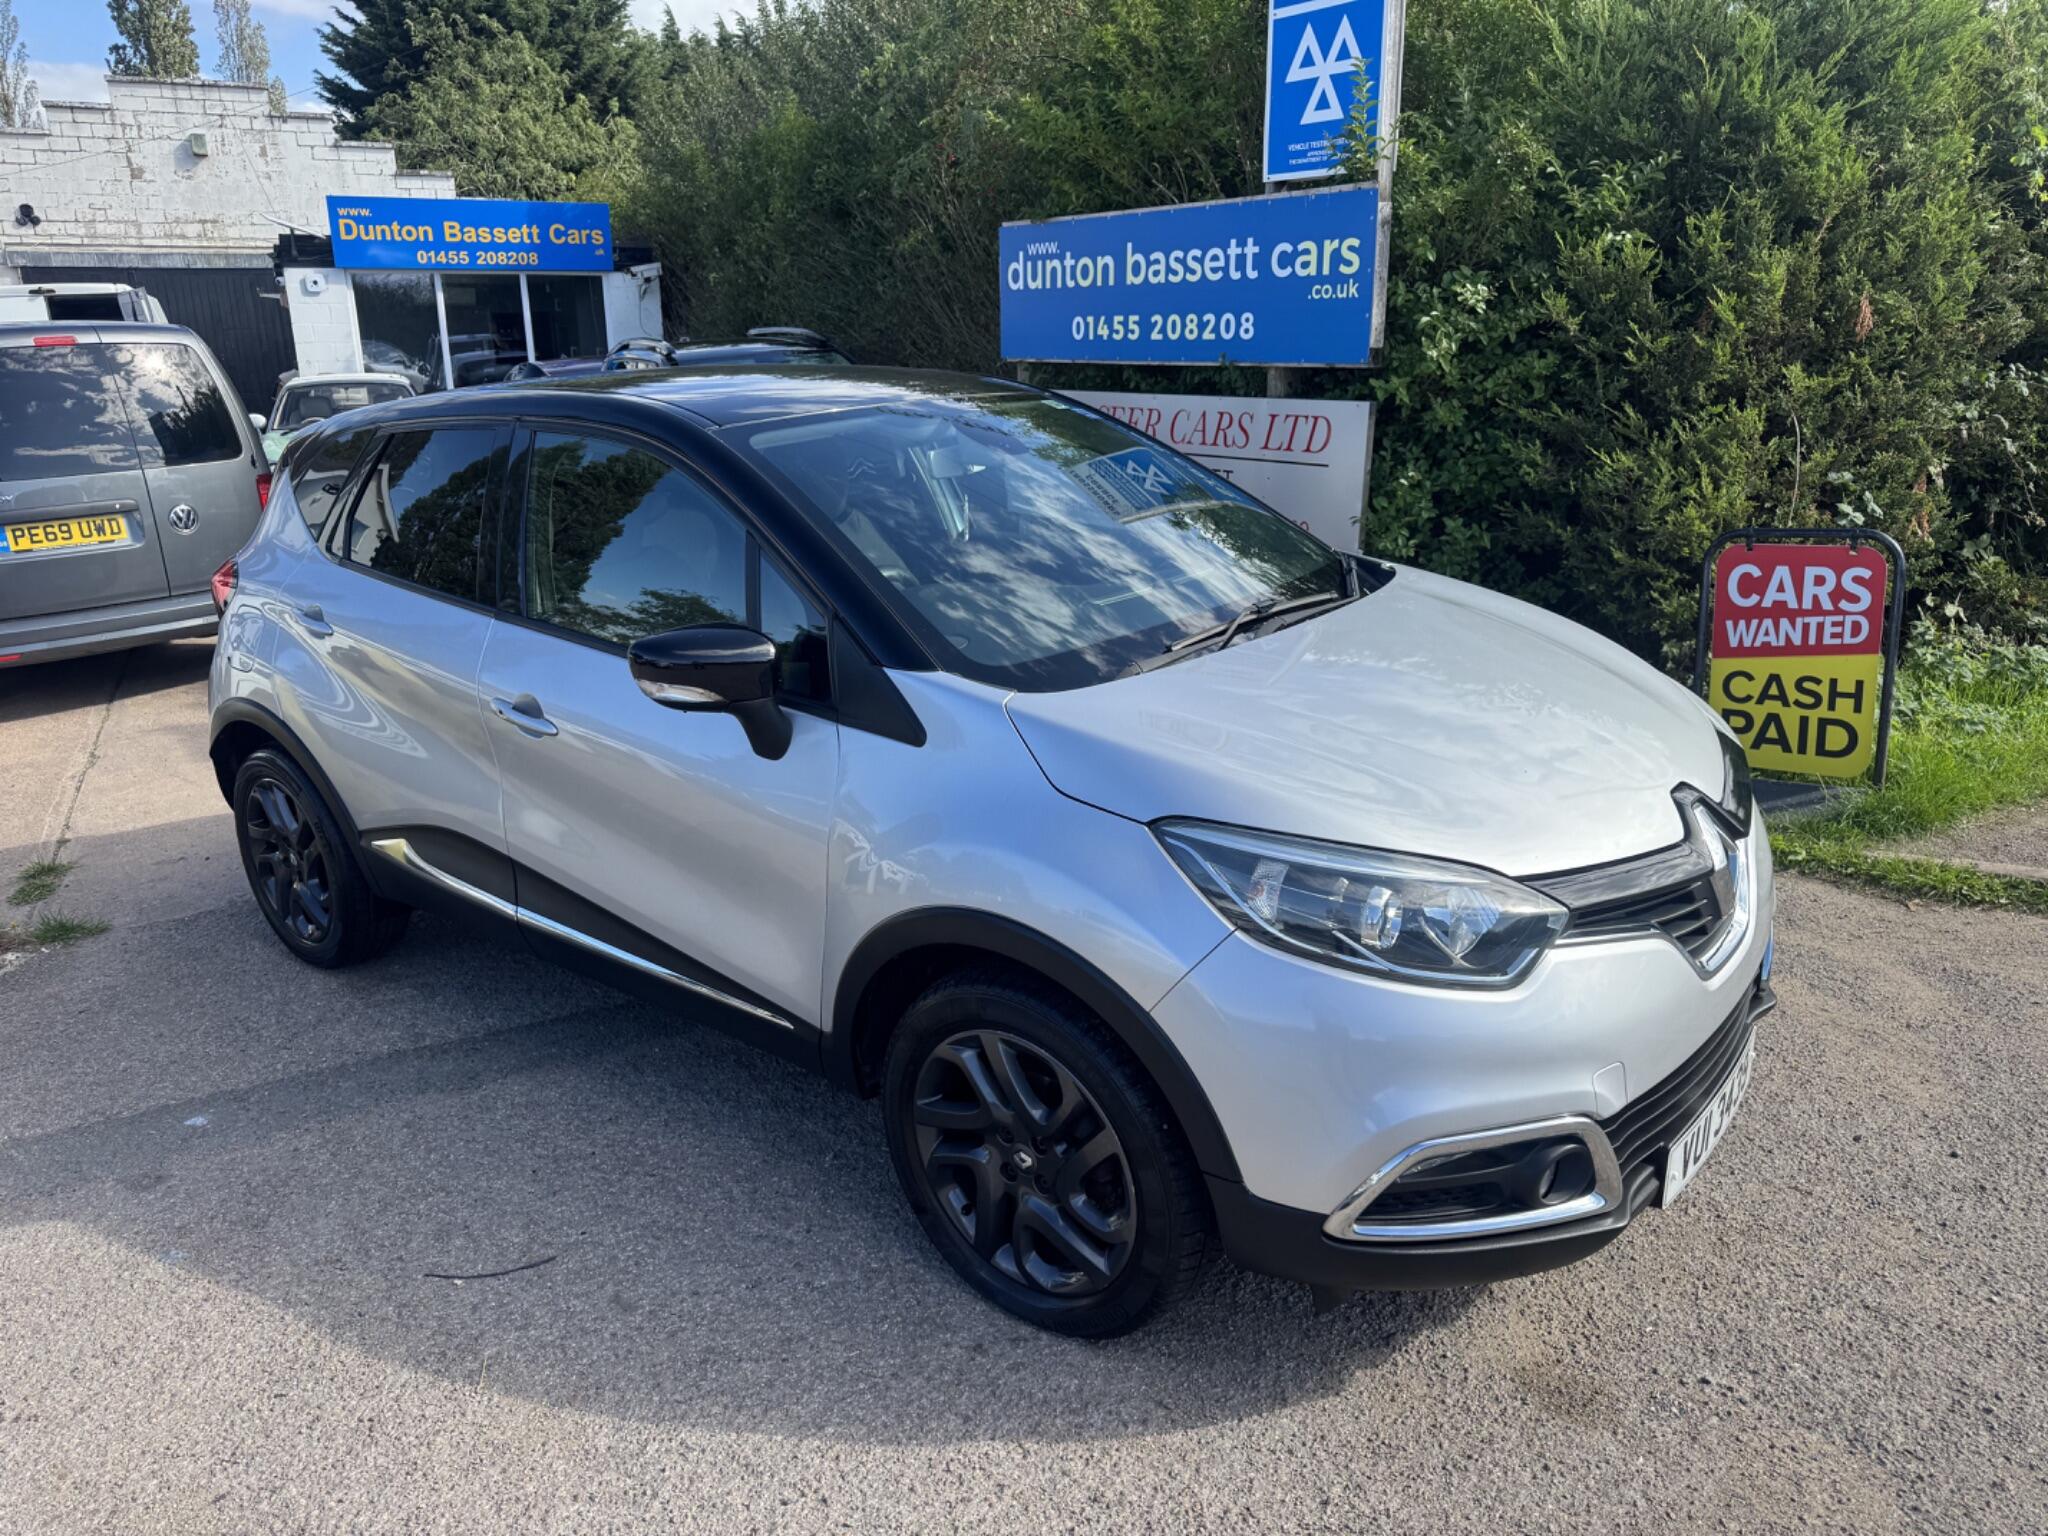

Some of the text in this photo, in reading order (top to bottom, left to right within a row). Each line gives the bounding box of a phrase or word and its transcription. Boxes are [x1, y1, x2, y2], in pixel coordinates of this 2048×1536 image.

[337, 207, 372, 217] www.
[338, 218, 605, 245] Dunton Bassett Cars
[416, 250, 539, 265] 01455 208208
[1007, 236, 1361, 291] dunton bassett cars
[1027, 241, 1060, 256] www.
[1307, 278, 1359, 300] .co.uk
[1072, 312, 1255, 341] 01455 208208
[1169, 408, 1254, 450] CARS
[1260, 413, 1332, 454] LTD
[10, 517, 122, 547] PE69 UWD
[1727, 563, 1873, 612] CARS
[1725, 614, 1869, 648] WANTED
[1722, 670, 1865, 714] CASH
[1721, 708, 1859, 758] PAID
